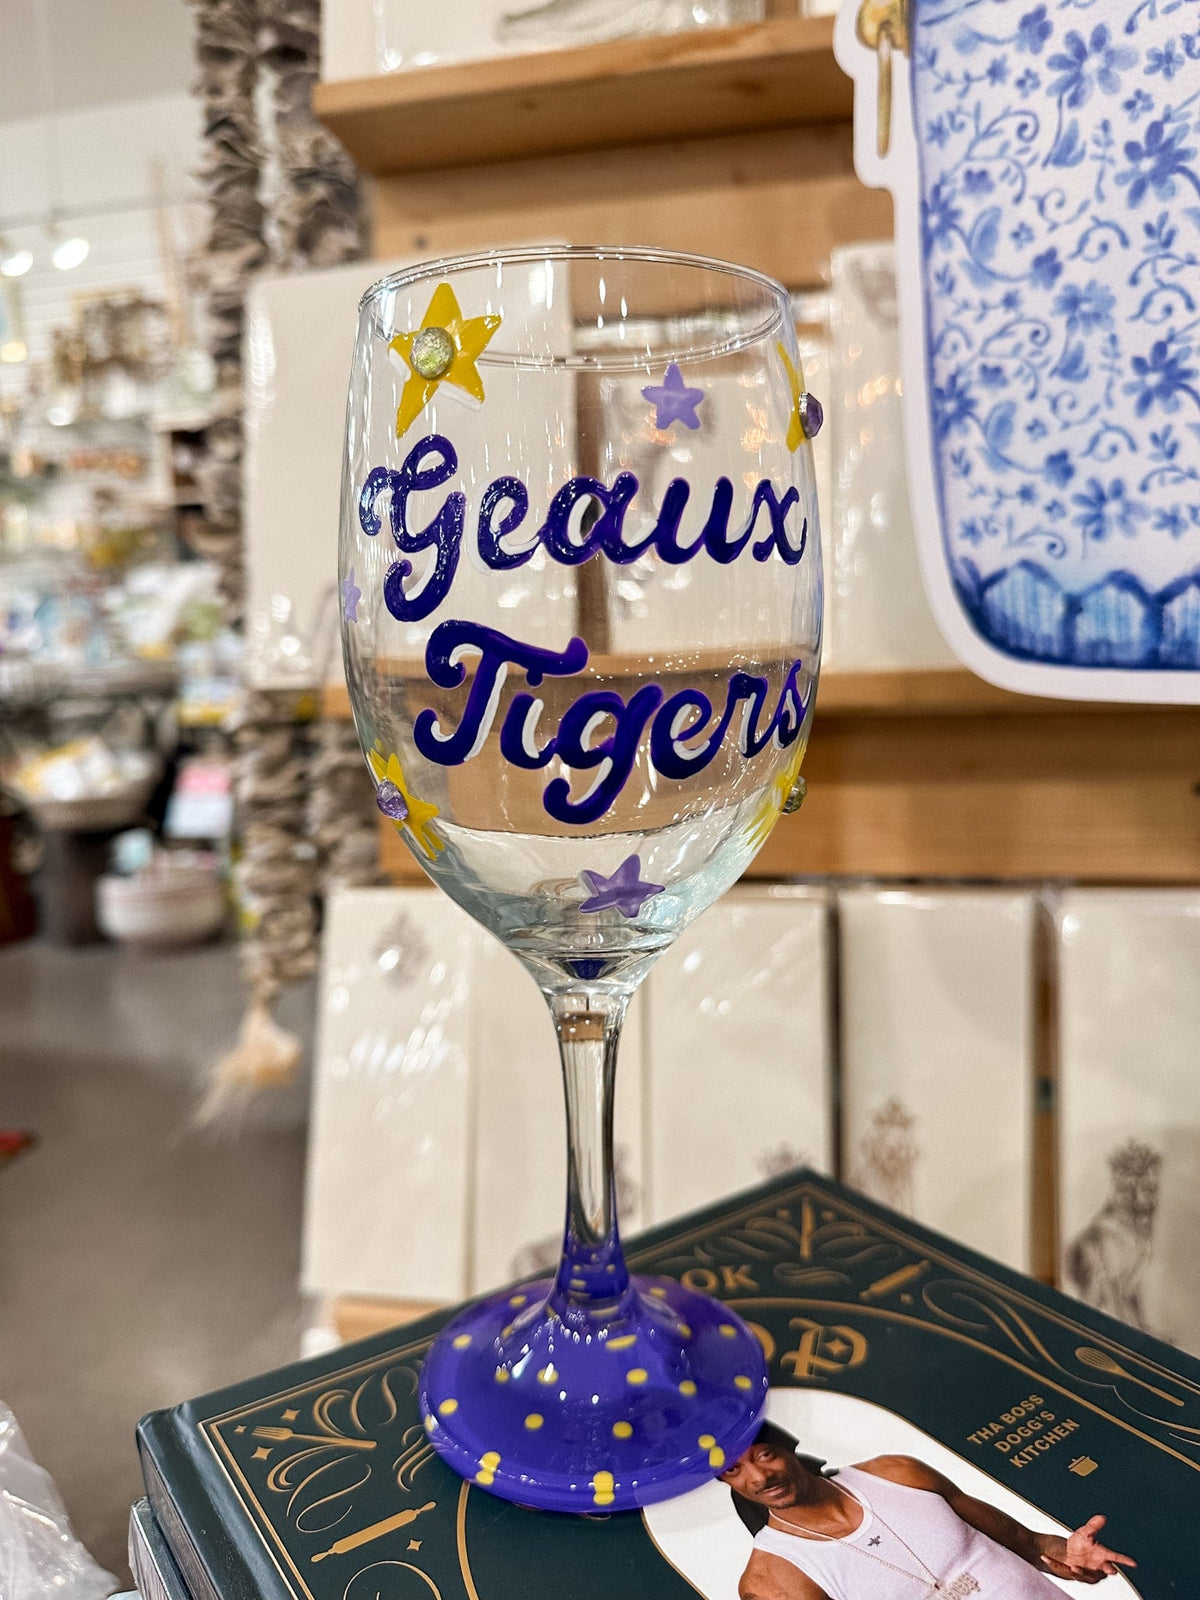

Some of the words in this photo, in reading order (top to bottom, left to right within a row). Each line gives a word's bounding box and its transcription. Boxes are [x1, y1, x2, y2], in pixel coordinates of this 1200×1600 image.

[359, 434, 807, 622] Geaux
[413, 619, 813, 825] Tigers
[966, 1421, 1005, 1445] THA
[1000, 1394, 1044, 1424] BOSS
[994, 1410, 1056, 1453] DOGG'S
[1009, 1418, 1080, 1468] KITCHEN
